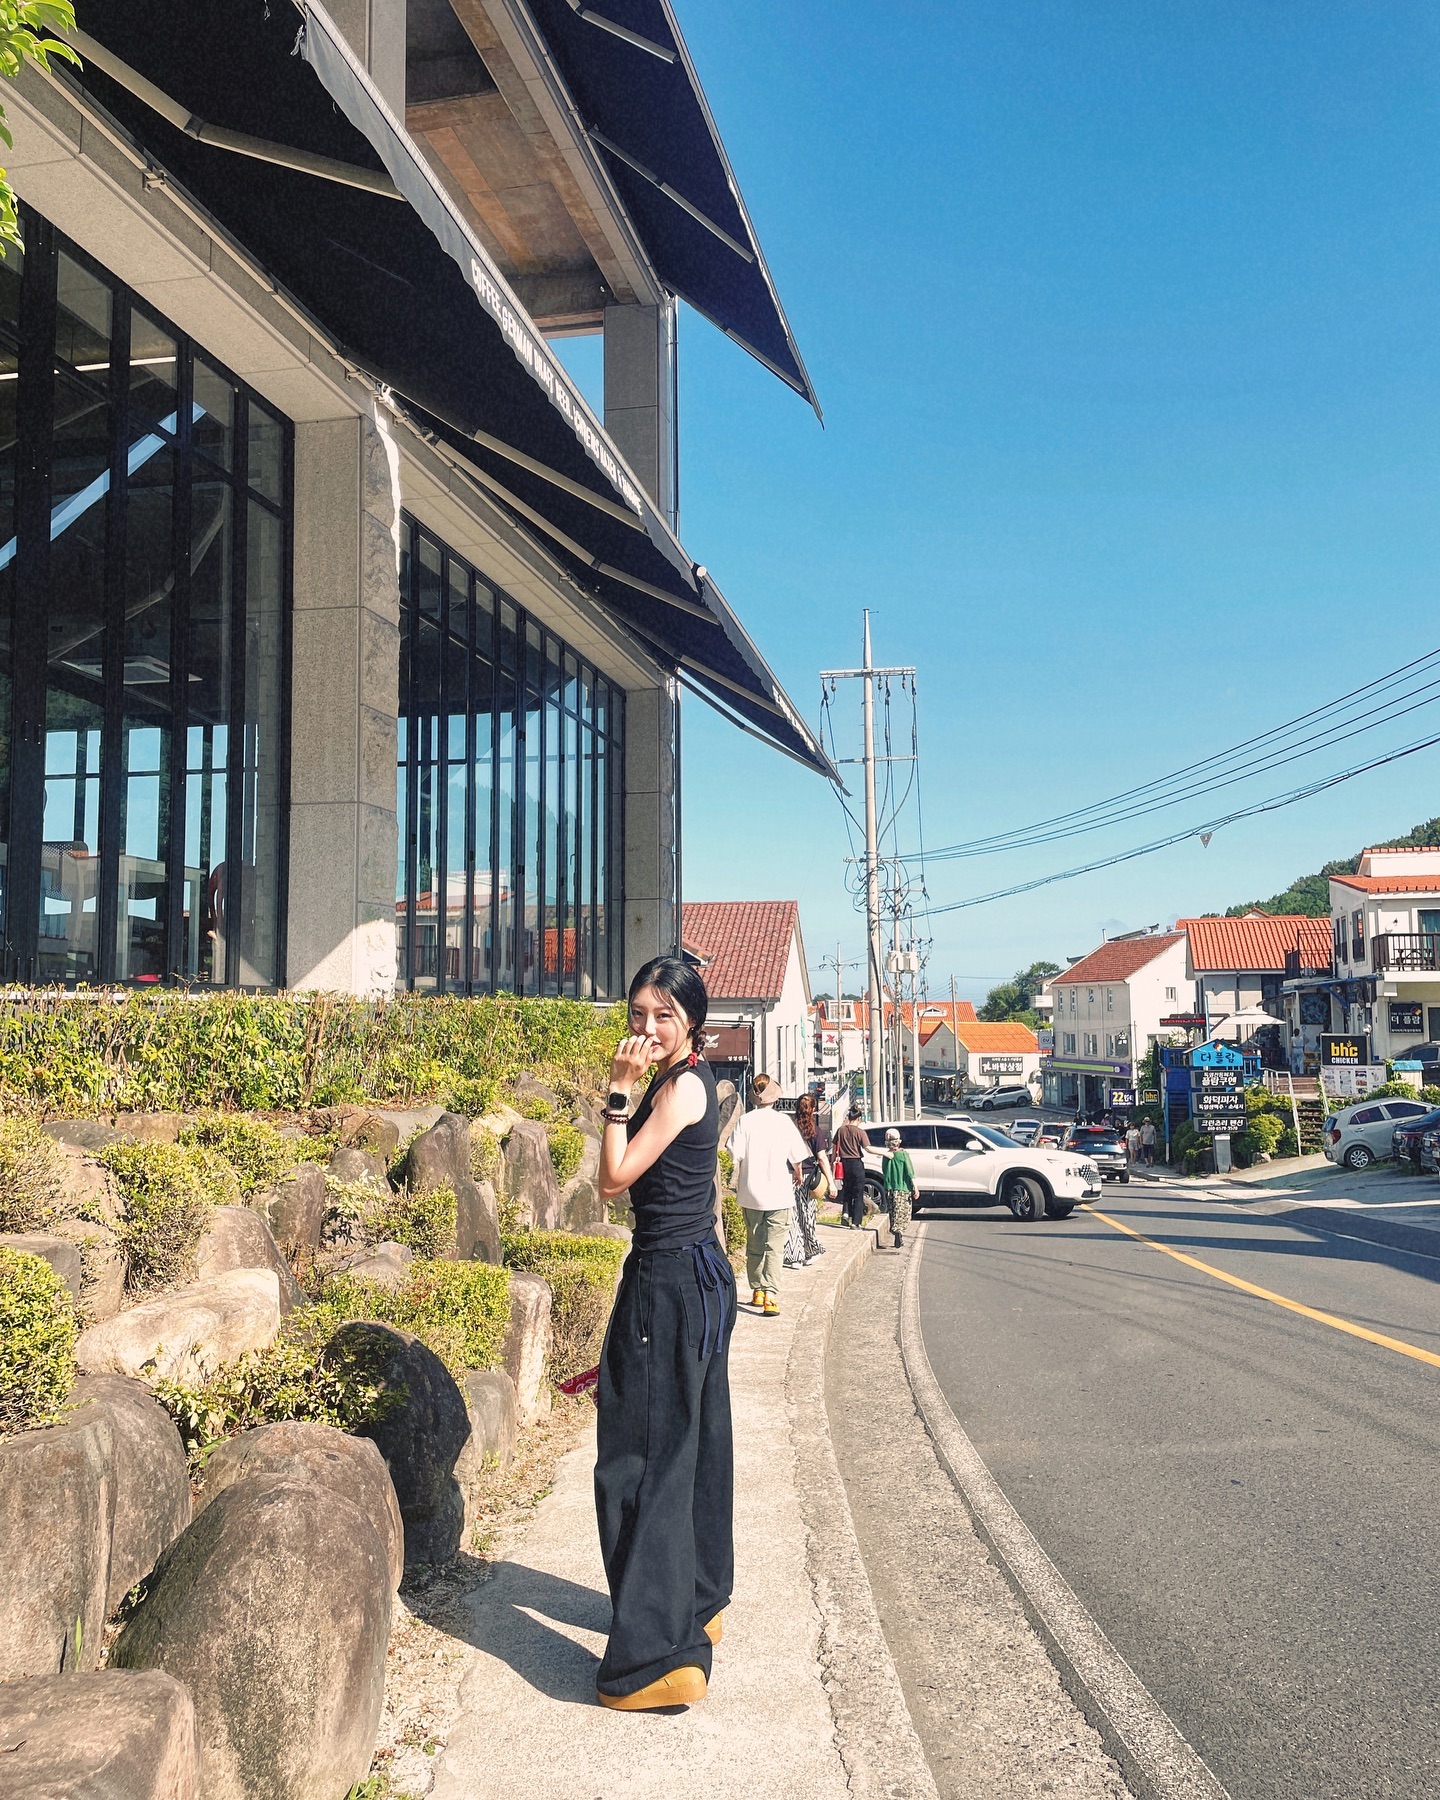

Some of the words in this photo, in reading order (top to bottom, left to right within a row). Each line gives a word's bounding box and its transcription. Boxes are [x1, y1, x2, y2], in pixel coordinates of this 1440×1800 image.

[502, 306, 533, 366] GERMAN
[533, 348, 554, 394] DRAFT
[1391, 1015, 1399, 1025] 더
[1330, 1042, 1358, 1057] bhc
[1200, 1052, 1211, 1062] 더
[1215, 1051, 1235, 1064] 플람
